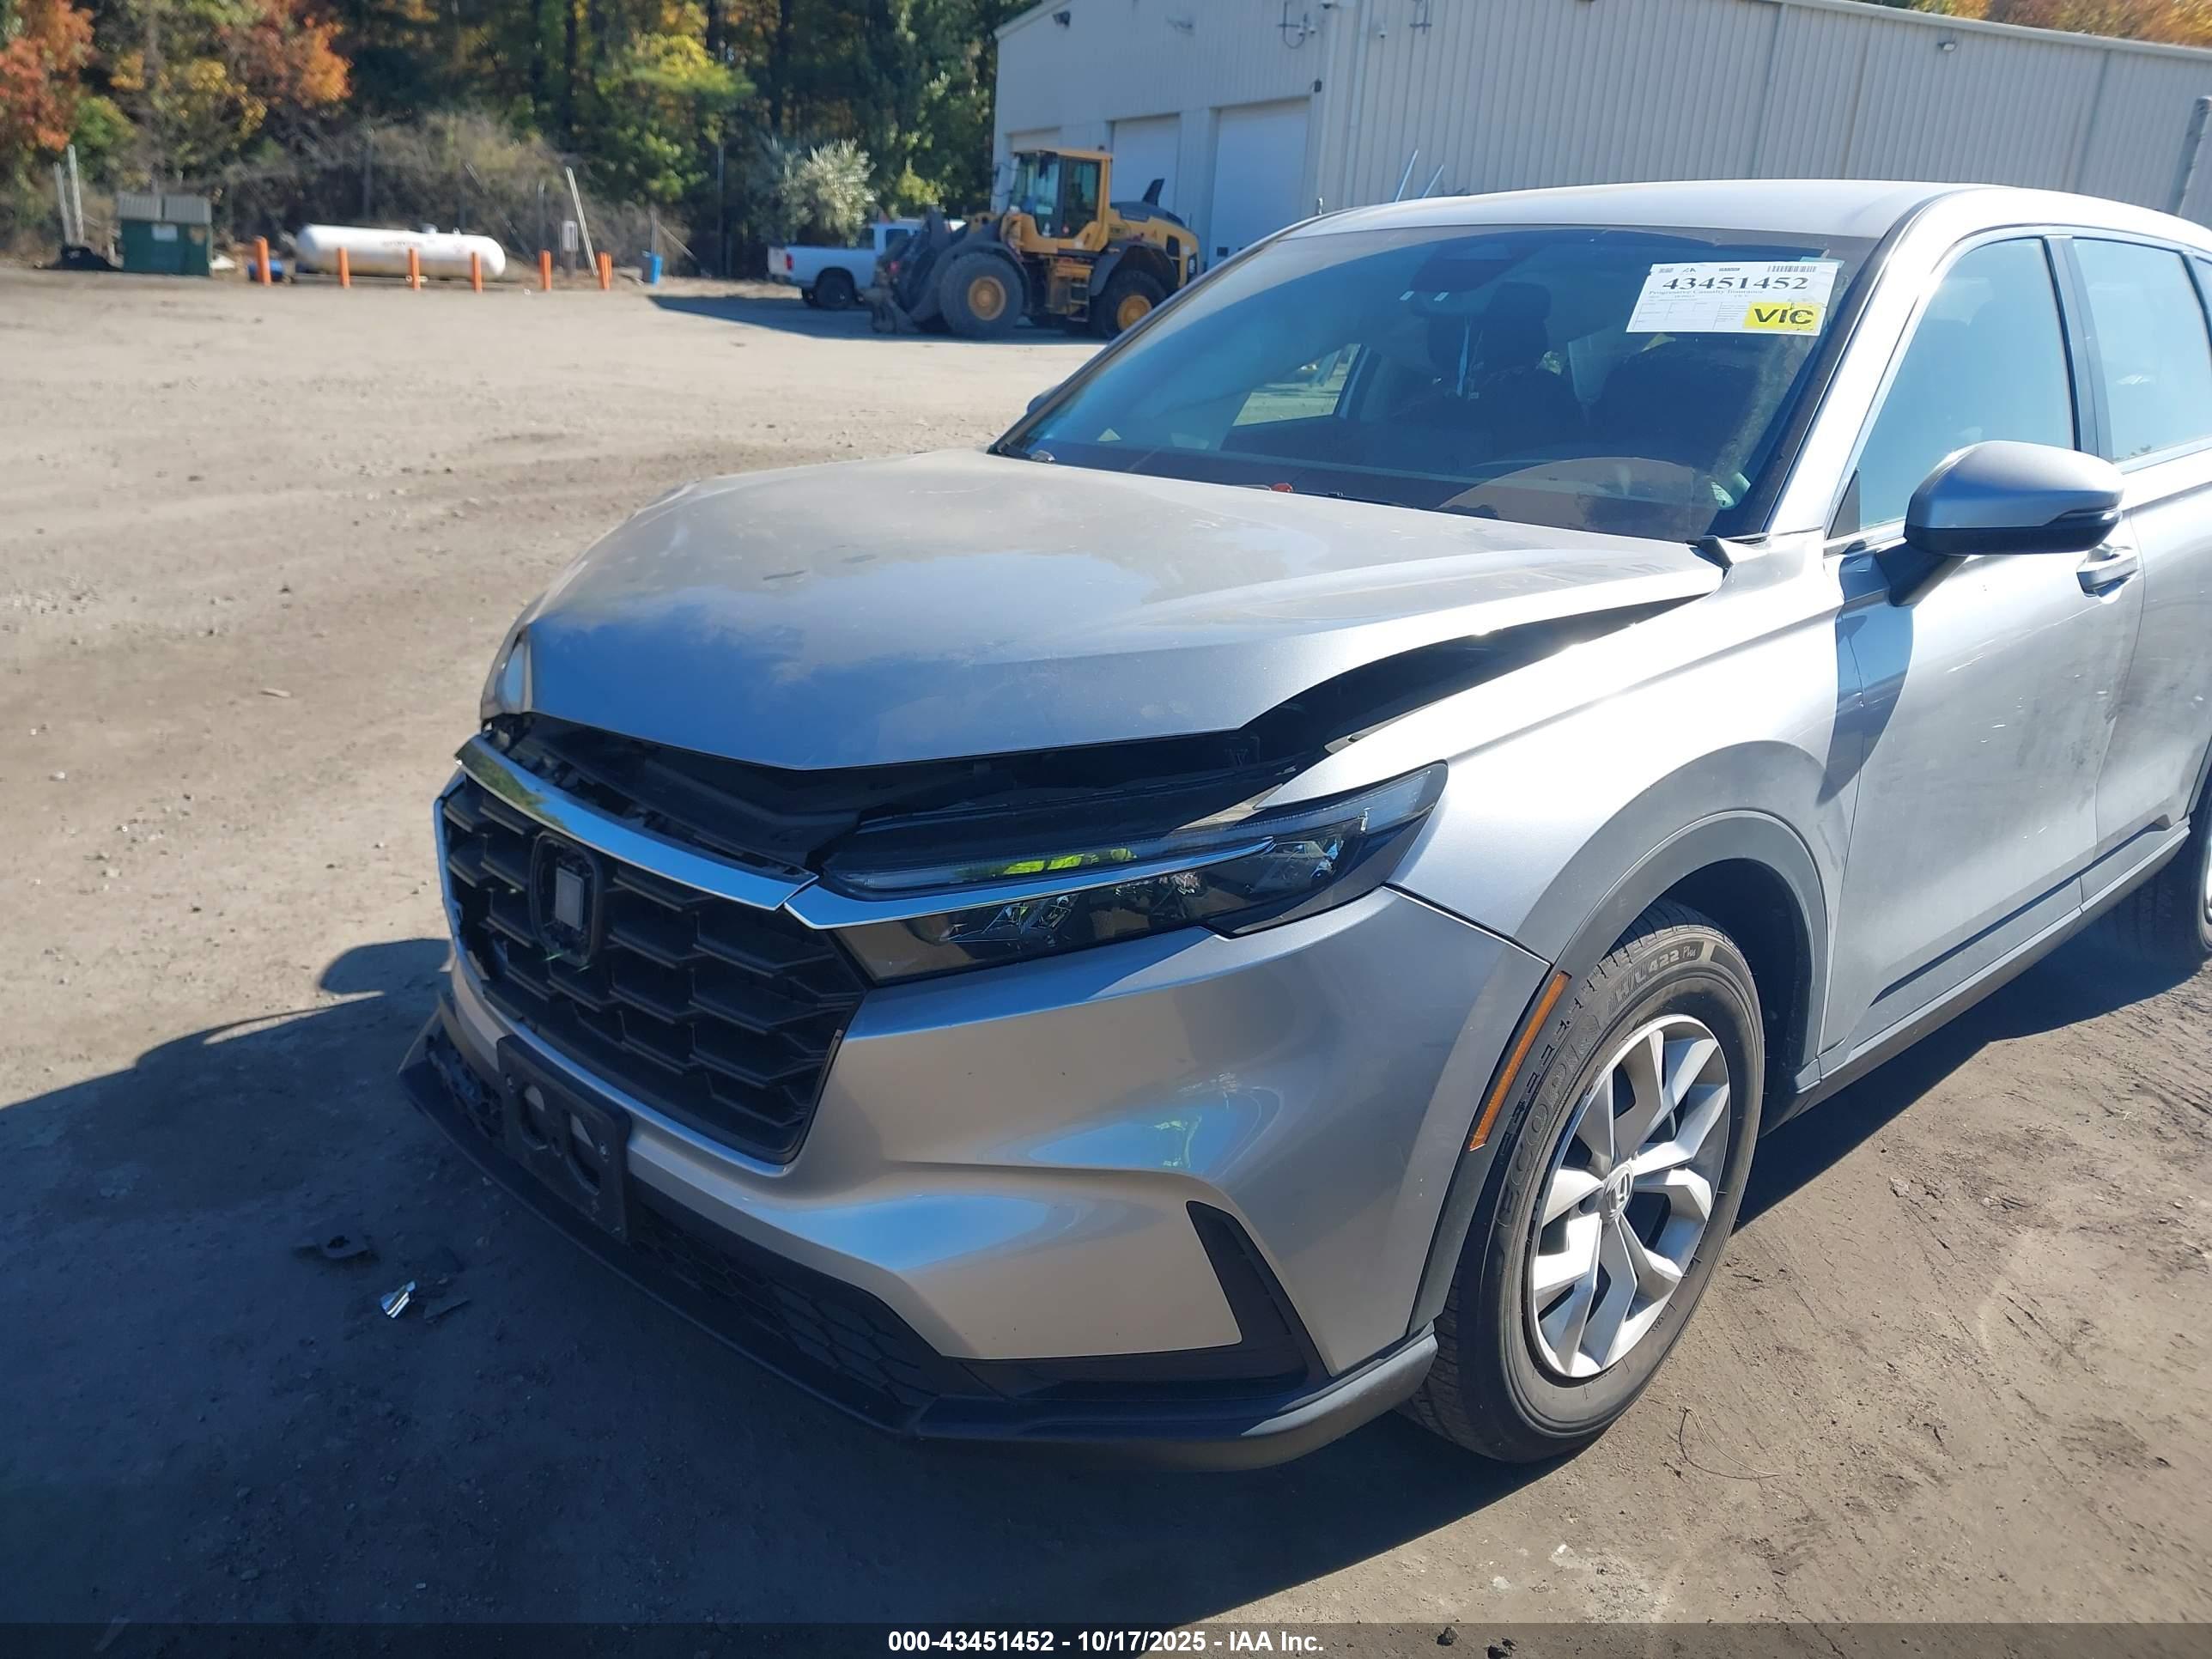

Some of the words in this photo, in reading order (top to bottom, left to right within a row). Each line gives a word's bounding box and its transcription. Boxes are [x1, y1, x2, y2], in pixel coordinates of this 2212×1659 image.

[1662, 276, 1808, 289] 43451452
[1754, 309, 1814, 325] VIC
[1648, 949, 1680, 973] 422
[1682, 945, 1697, 959] Plus
